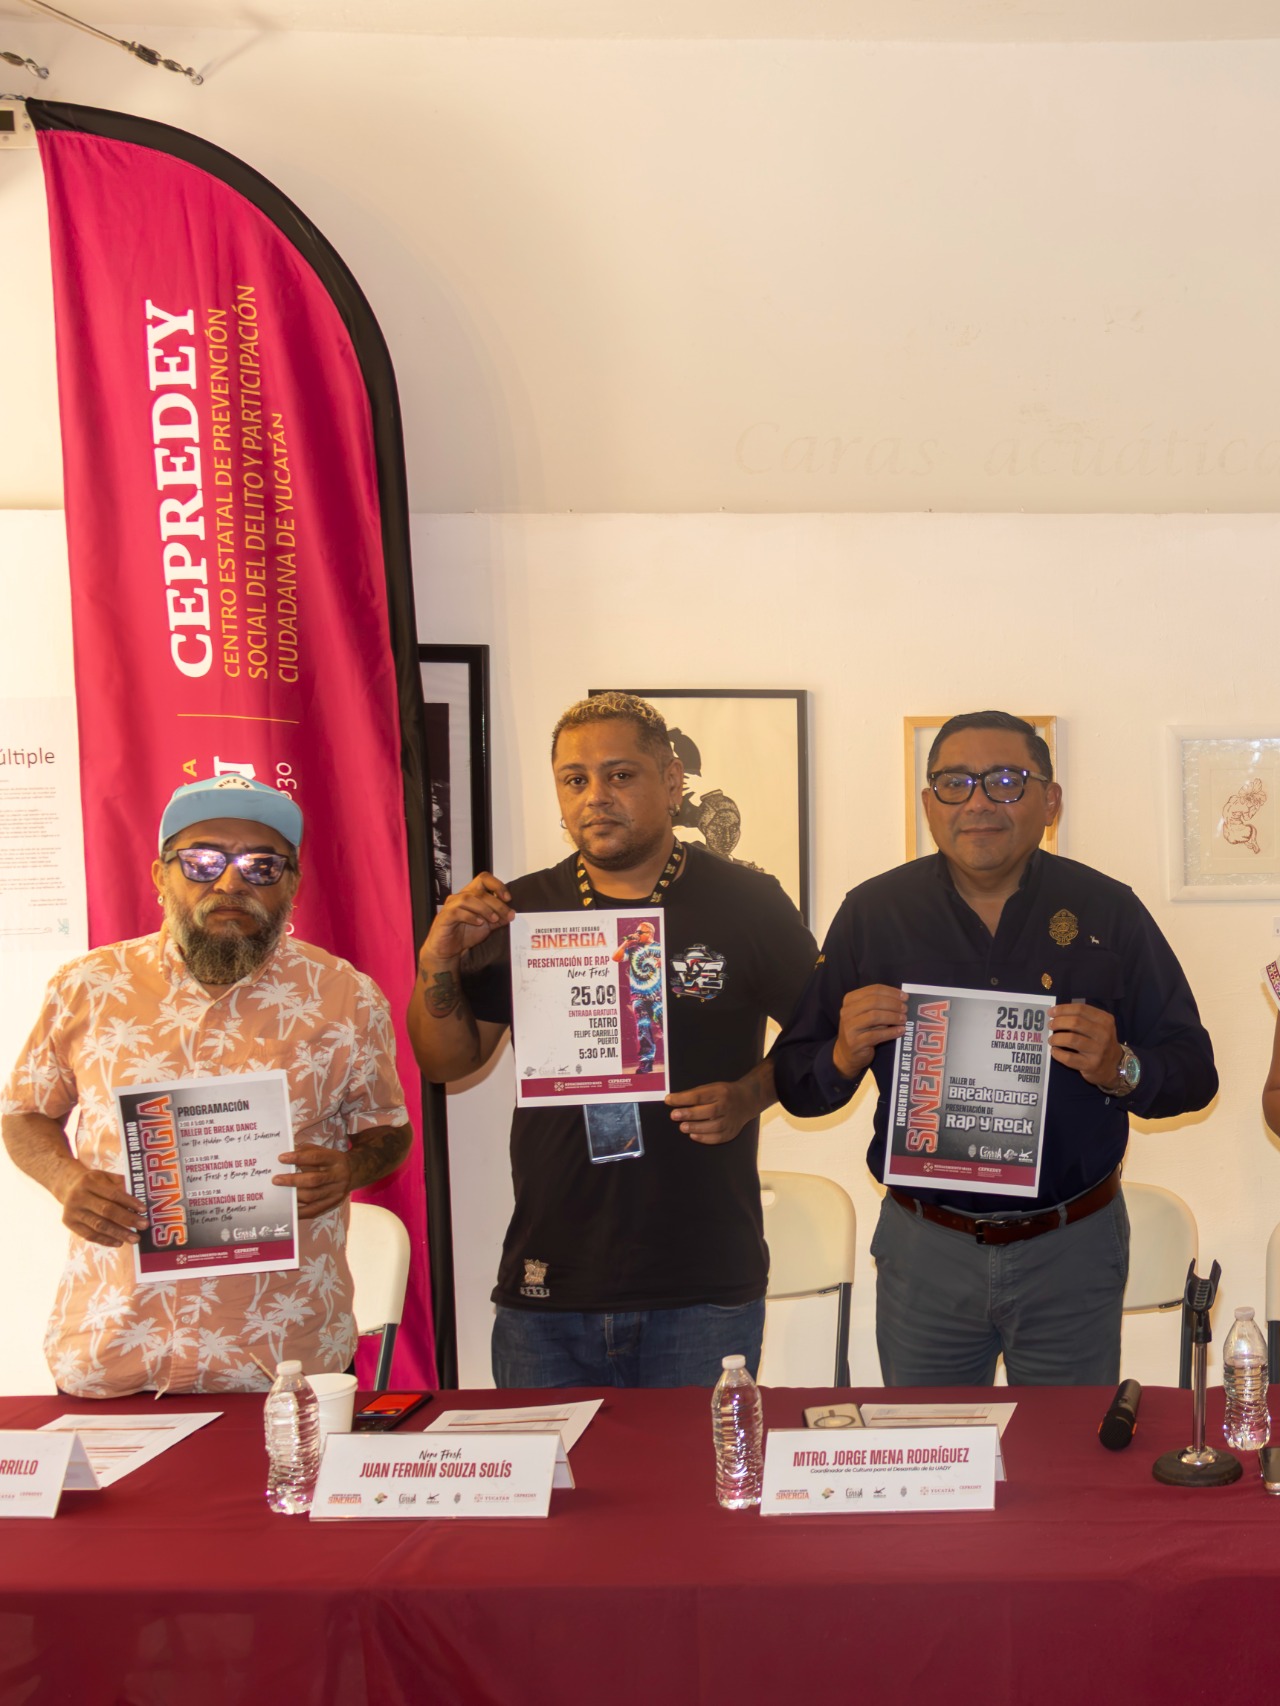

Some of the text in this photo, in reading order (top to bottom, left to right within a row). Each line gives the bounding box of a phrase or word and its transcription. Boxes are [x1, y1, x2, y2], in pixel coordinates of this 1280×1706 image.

[146, 300, 213, 678] CEPREDEY
[231, 285, 268, 679] SOCIAL DEL DELITO Y PARTICIPACIÓN
[204, 309, 240, 677] CENTRO ESTATAL DE PREVENCIÓN
[267, 413, 298, 683] CIUDADANA DE YUCATÁN
[531, 932, 607, 949] SINERGIA
[527, 956, 609, 968] PRESENTACIÓN DE RAP
[570, 985, 616, 1006] 25.09
[589, 1017, 617, 1028] TEATRO
[996, 1007, 1045, 1031] 25.09
[574, 1029, 618, 1038] FELIPE CARRILLO
[598, 1037, 618, 1045] PUERTO
[996, 1030, 1043, 1043] DE 3 A 9 P.M.
[579, 1047, 618, 1059] 5:30 P.M.
[991, 1041, 1042, 1052] ENTRADA GRATUITA
[1012, 1052, 1041, 1065] TEATRO
[896, 1021, 914, 1126] ENCUENTRO DE ARTE URBANO
[906, 1000, 950, 1153] SINERGIA
[994, 1063, 1040, 1074] FELIPE CARRILLO
[950, 1076, 967, 1085] TALLER
[1018, 1074, 1040, 1083] PUERTO
[177, 1099, 249, 1117] PROGRAMACIÓN
[946, 1104, 993, 1115] PRESENTACIÓN DE
[180, 1122, 257, 1137] TALLER DE BREAK DANCE
[136, 1094, 188, 1247] SINERGIA
[793, 1445, 969, 1467] MTRO. JORGE MENA RODRÍGUEZ
[0, 1459, 38, 1475] RRILLO
[359, 1460, 512, 1478] JUAN FERMÍN SOUZA SOLÍS
